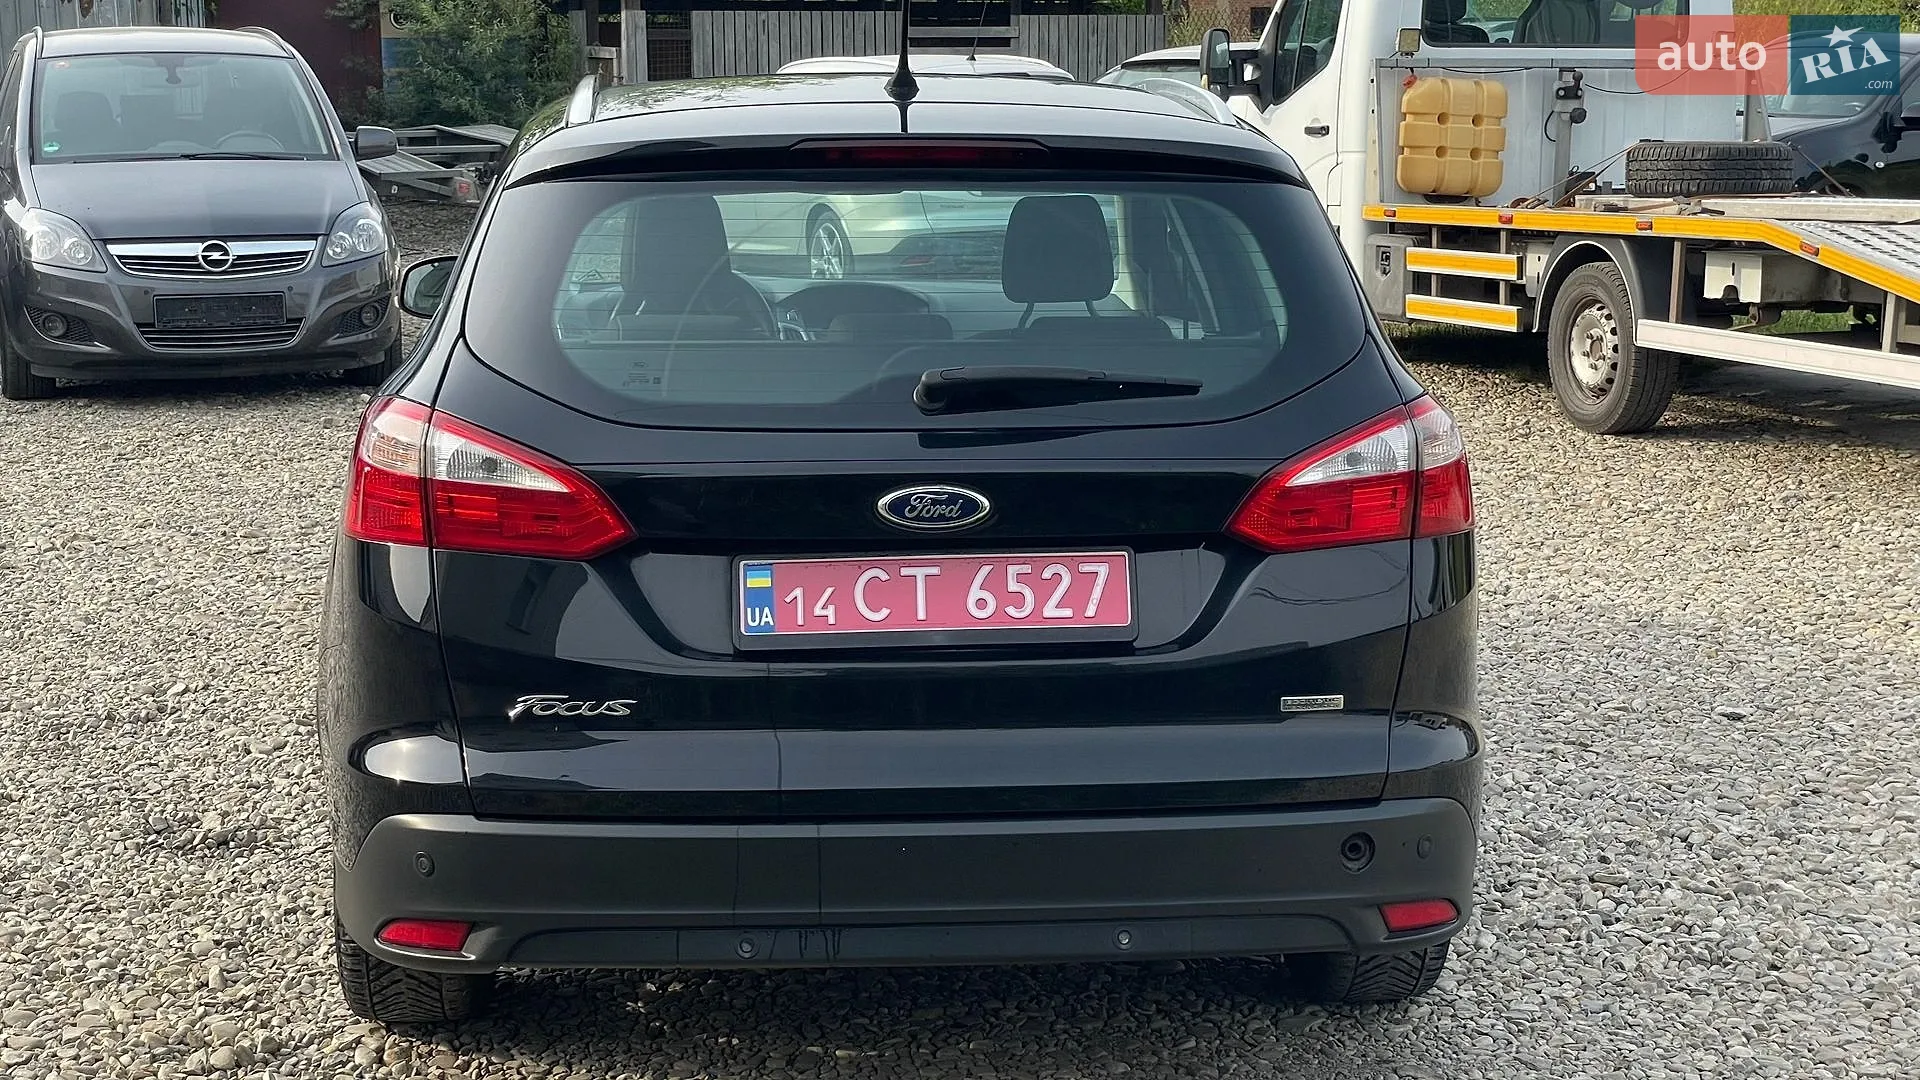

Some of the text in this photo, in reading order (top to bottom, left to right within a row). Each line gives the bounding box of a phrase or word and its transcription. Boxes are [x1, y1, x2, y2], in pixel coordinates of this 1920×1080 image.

[904, 493, 964, 518] Ford
[784, 562, 1110, 626] 14 CT 6527
[747, 607, 774, 627] UA
[508, 694, 638, 718] Focus
